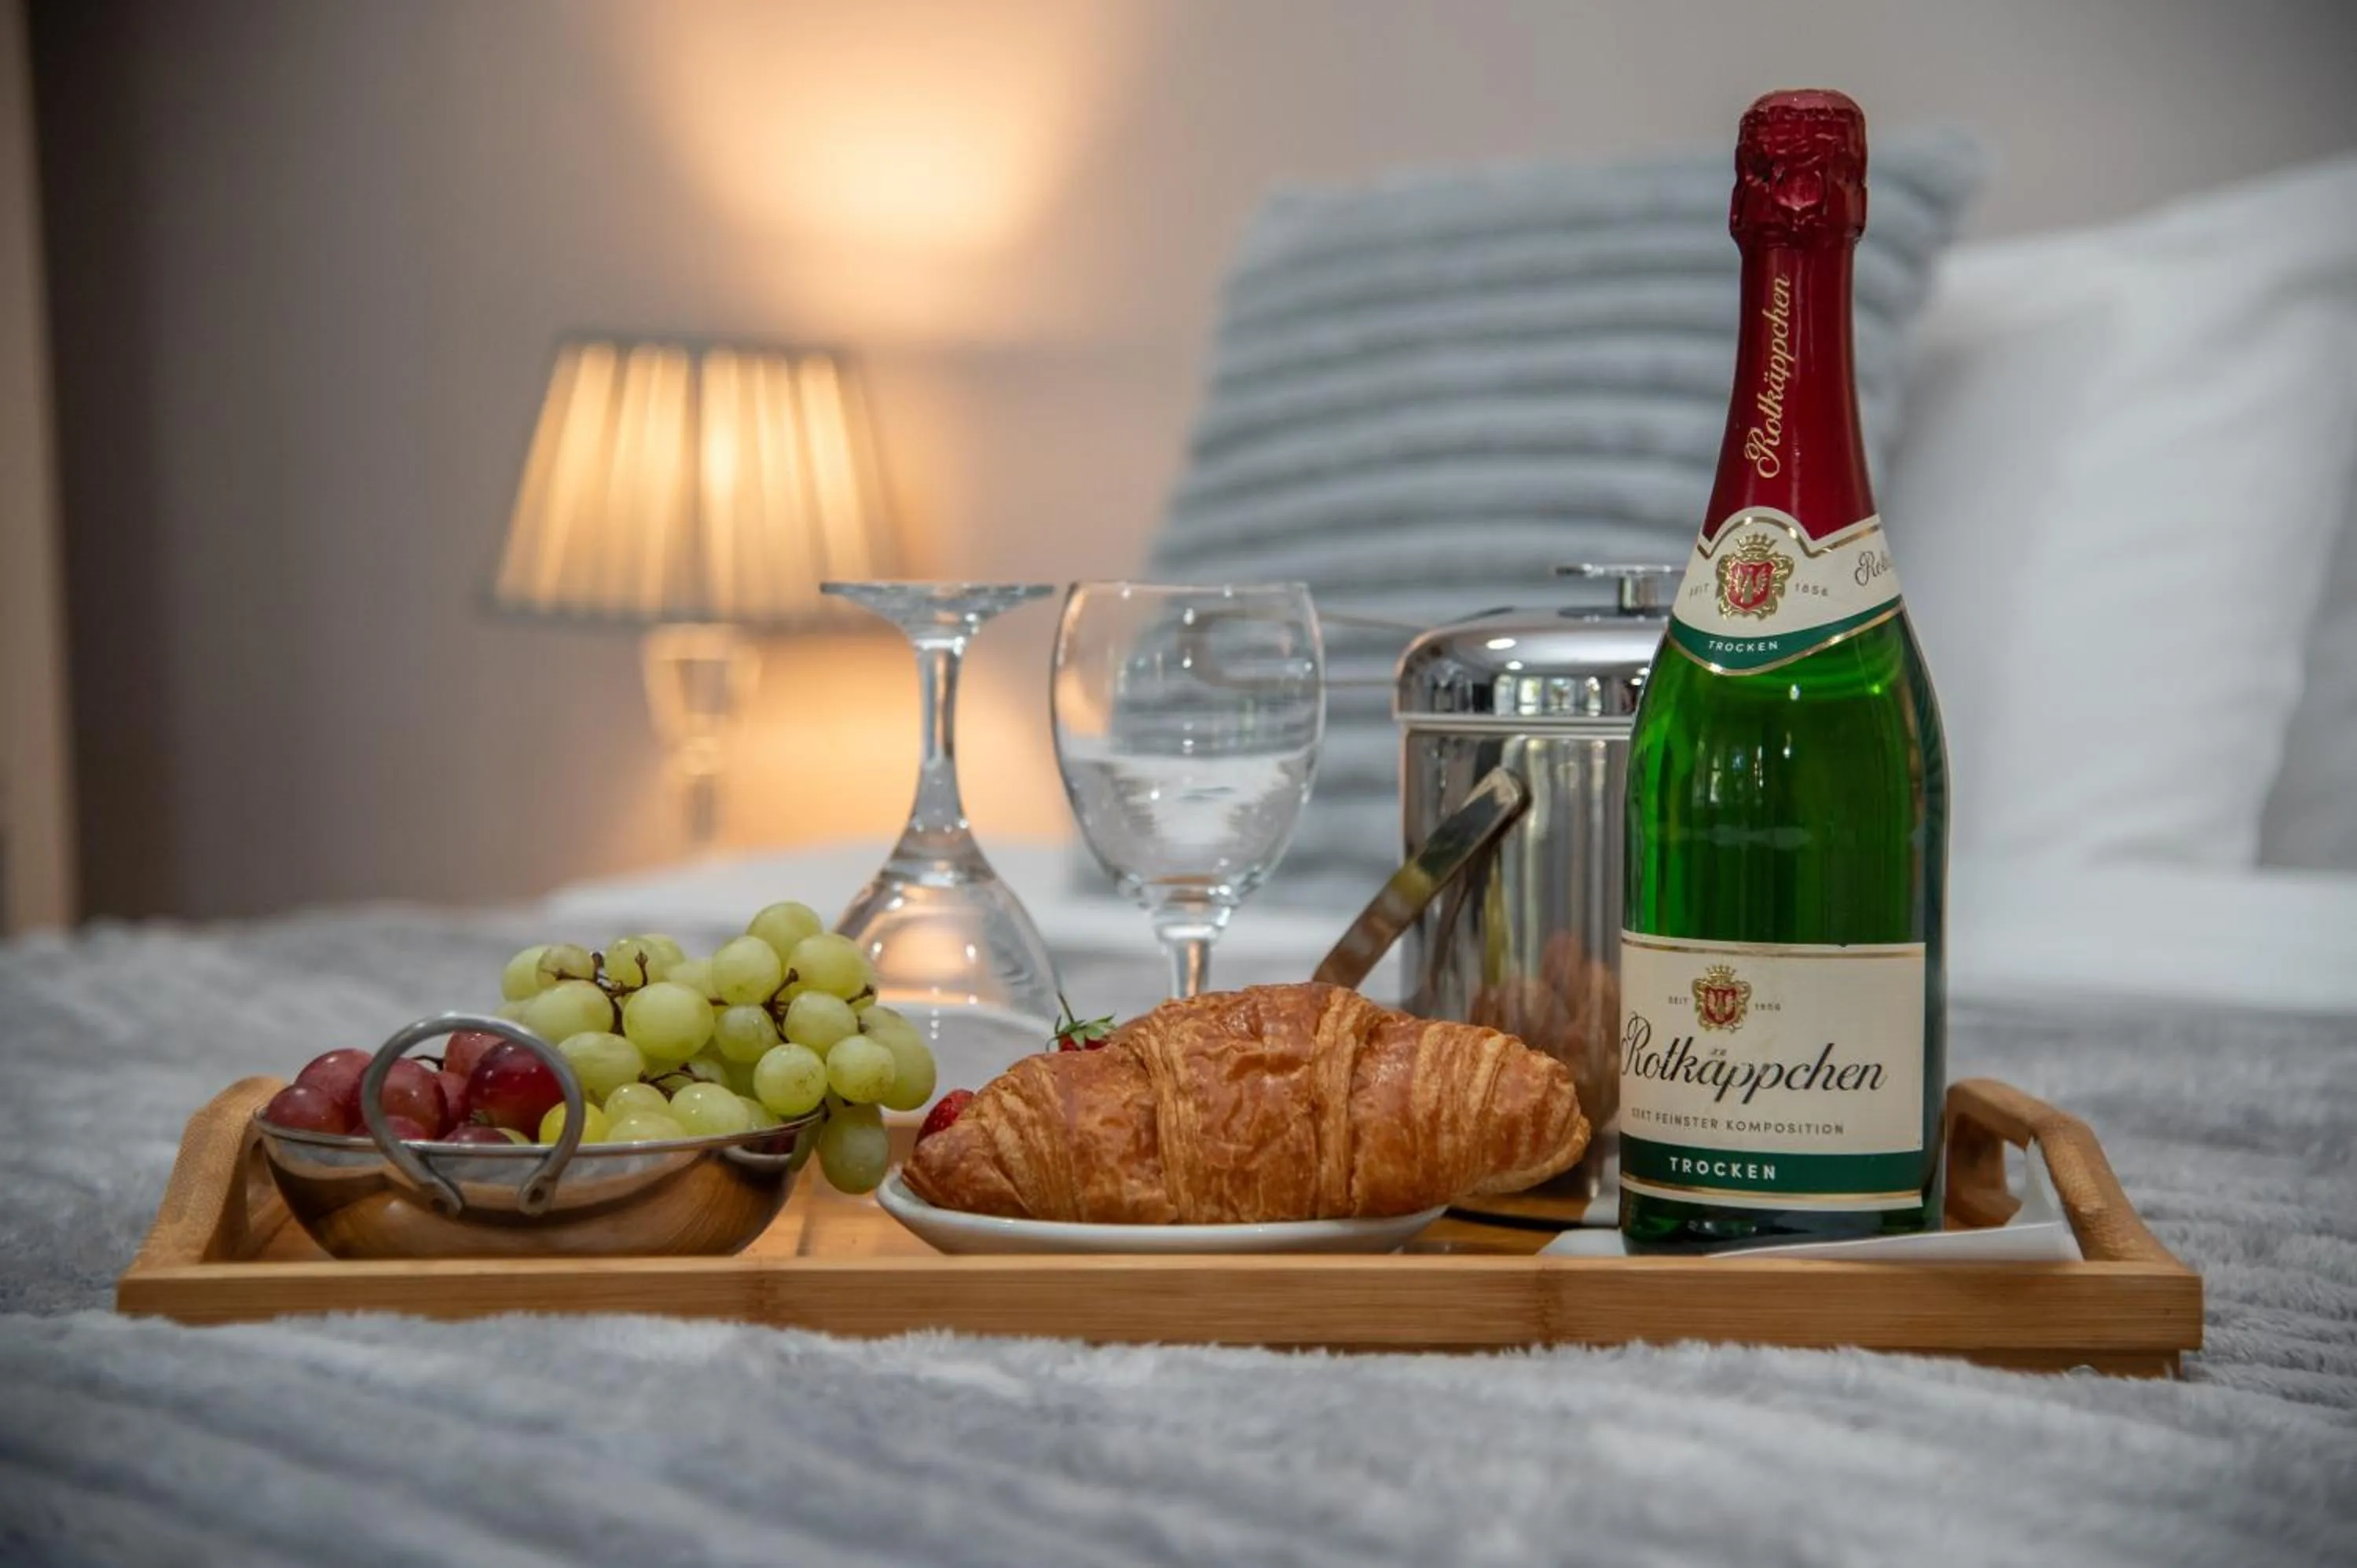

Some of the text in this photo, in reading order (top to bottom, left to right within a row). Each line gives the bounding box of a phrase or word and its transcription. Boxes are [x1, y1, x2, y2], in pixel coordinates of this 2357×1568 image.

[1743, 273, 1795, 478] Rotkäppchen
[1794, 582, 1829, 597] 1856
[1708, 640, 1779, 653] TROCKEN
[1621, 1011, 1888, 1105] Rotkäppchen
[1655, 1111, 1719, 1130] FEINSTER
[1726, 1119, 1845, 1135] KOMPOSITION
[1669, 1156, 1776, 1180] TROCKEN
